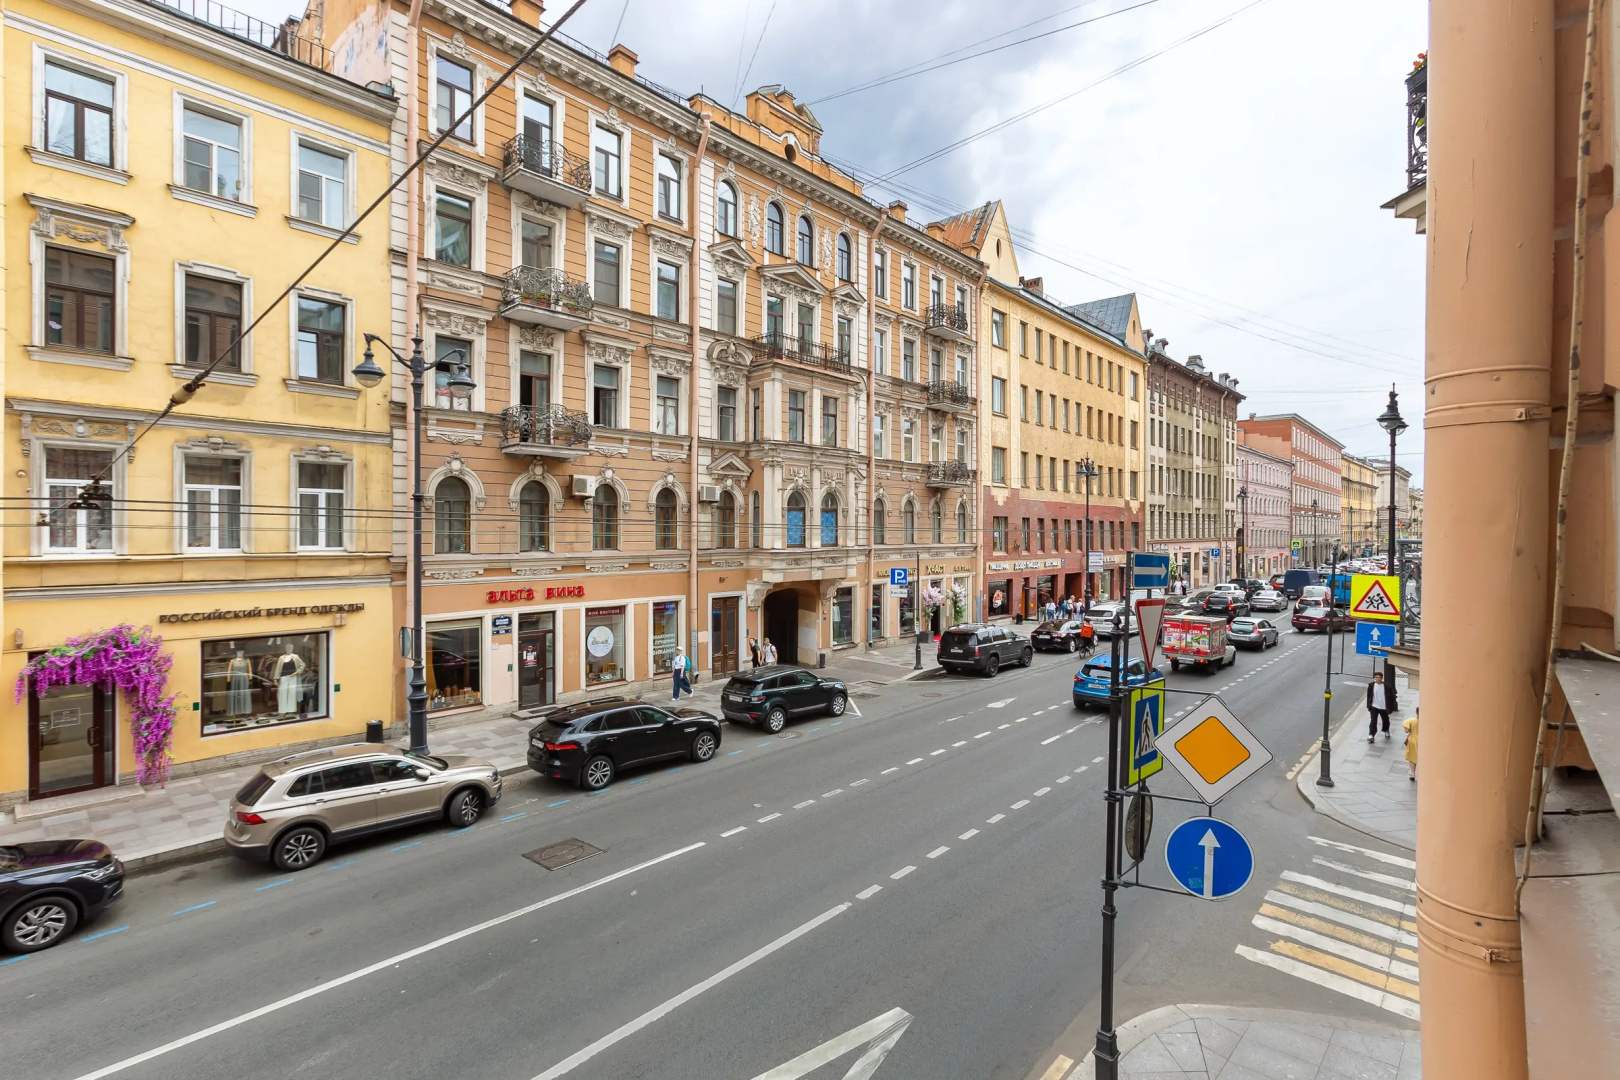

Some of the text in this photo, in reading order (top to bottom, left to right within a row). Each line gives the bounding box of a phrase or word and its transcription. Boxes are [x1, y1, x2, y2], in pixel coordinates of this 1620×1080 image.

[894, 569, 905, 584] P
[486, 585, 585, 603] альта вина
[158, 602, 365, 624] РОССИЙСКИЙ БРЕНД ОДЕЖДЫ
